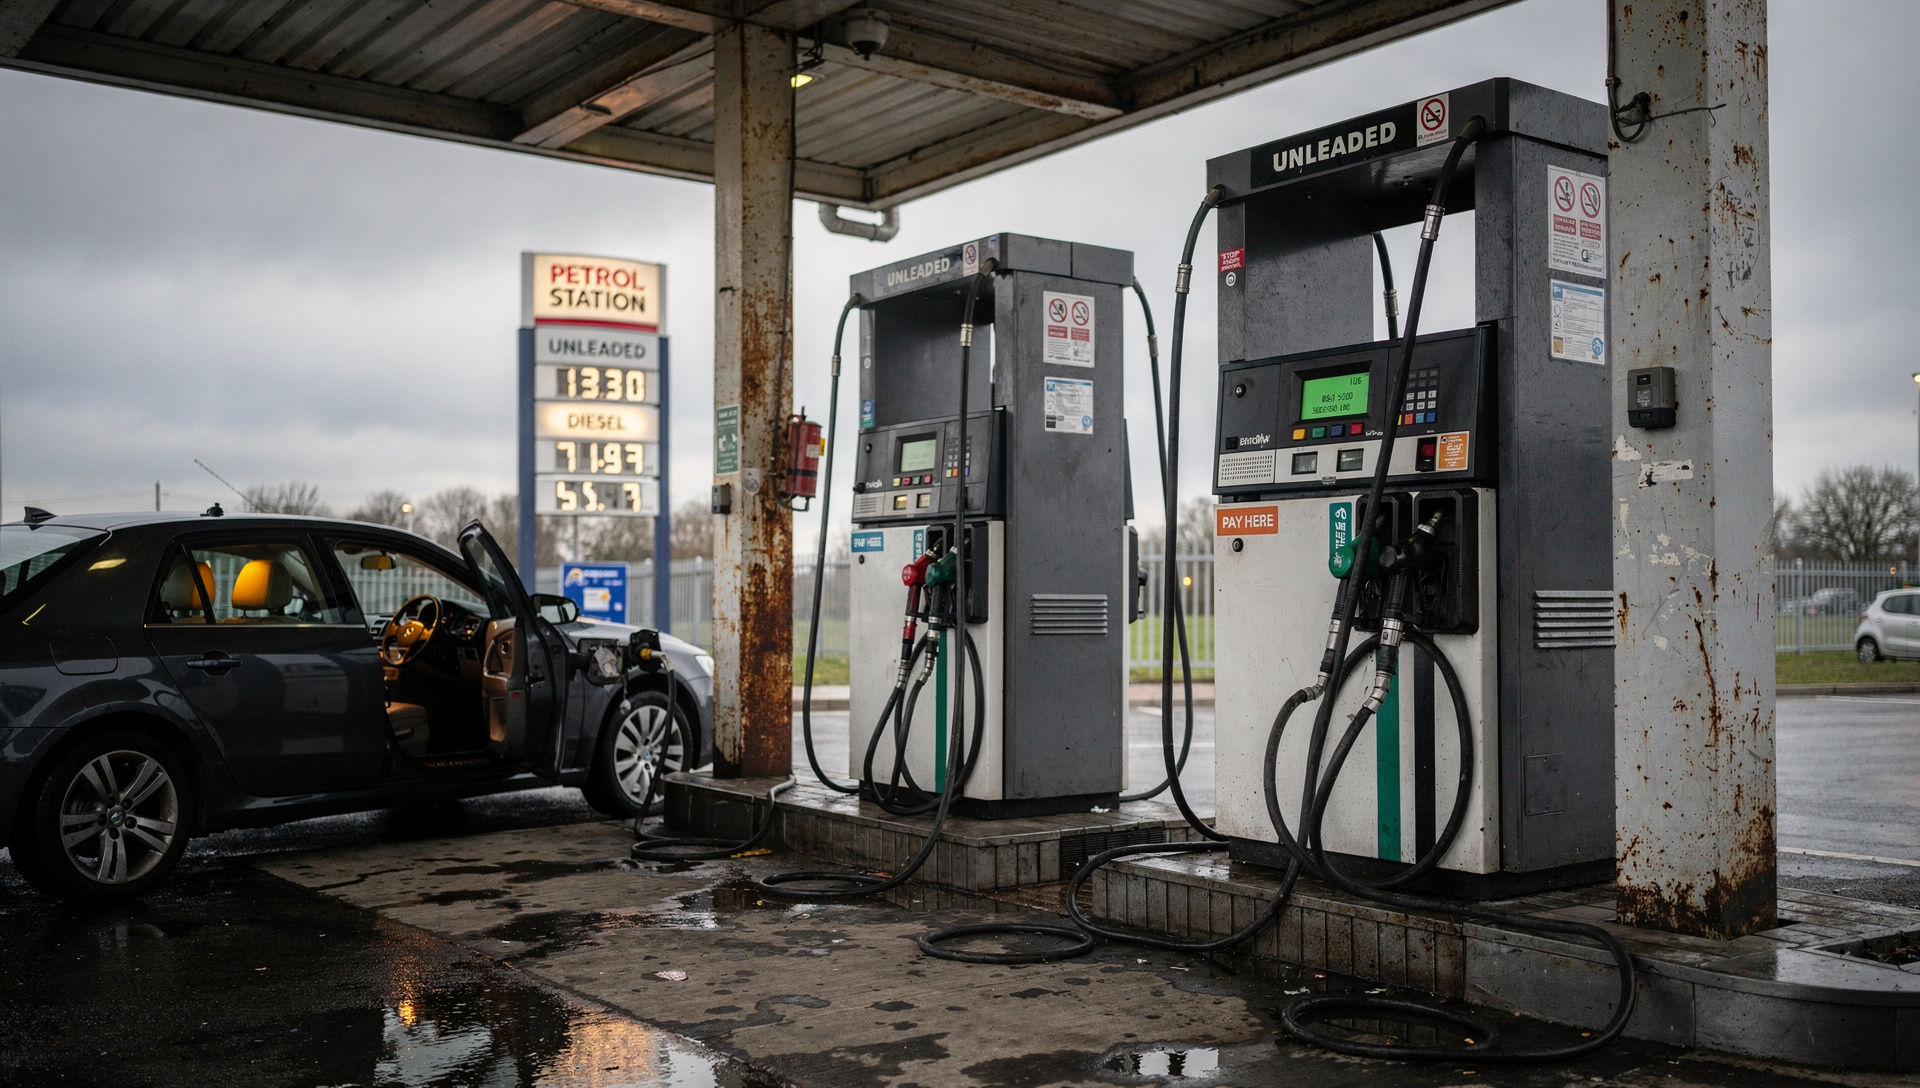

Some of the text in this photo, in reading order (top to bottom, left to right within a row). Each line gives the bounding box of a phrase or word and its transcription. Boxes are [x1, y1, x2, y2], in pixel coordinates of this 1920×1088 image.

[1273, 121, 1396, 172] UNLEADED
[550, 264, 645, 291] PETROL
[887, 257, 951, 287] UNLEADED
[550, 287, 645, 313] STATION
[549, 338, 646, 360] UNLEADED
[567, 412, 626, 432] DIESEL
[1222, 514, 1274, 529] PAY HERE
